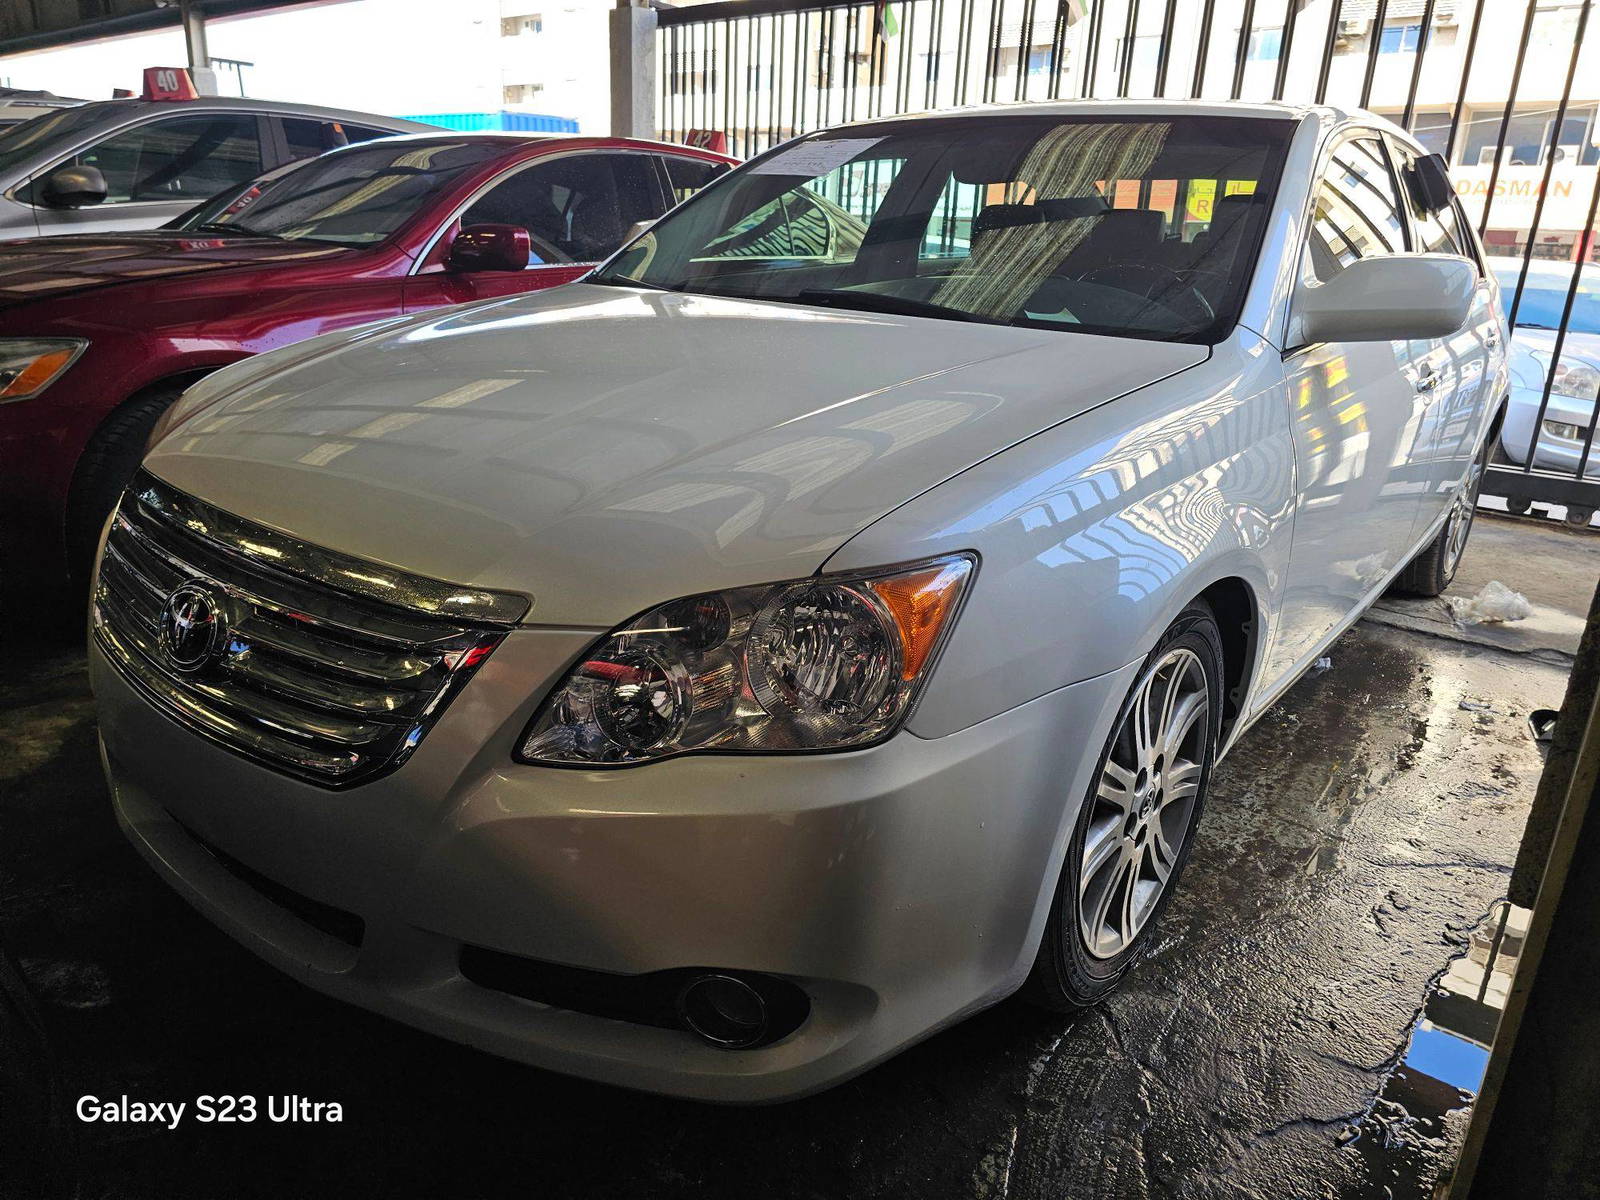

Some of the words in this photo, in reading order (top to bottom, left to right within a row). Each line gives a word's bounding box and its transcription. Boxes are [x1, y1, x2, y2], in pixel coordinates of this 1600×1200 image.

[157, 70, 179, 91] 40
[693, 131, 712, 149] 42
[1456, 179, 1573, 197] DASMAN
